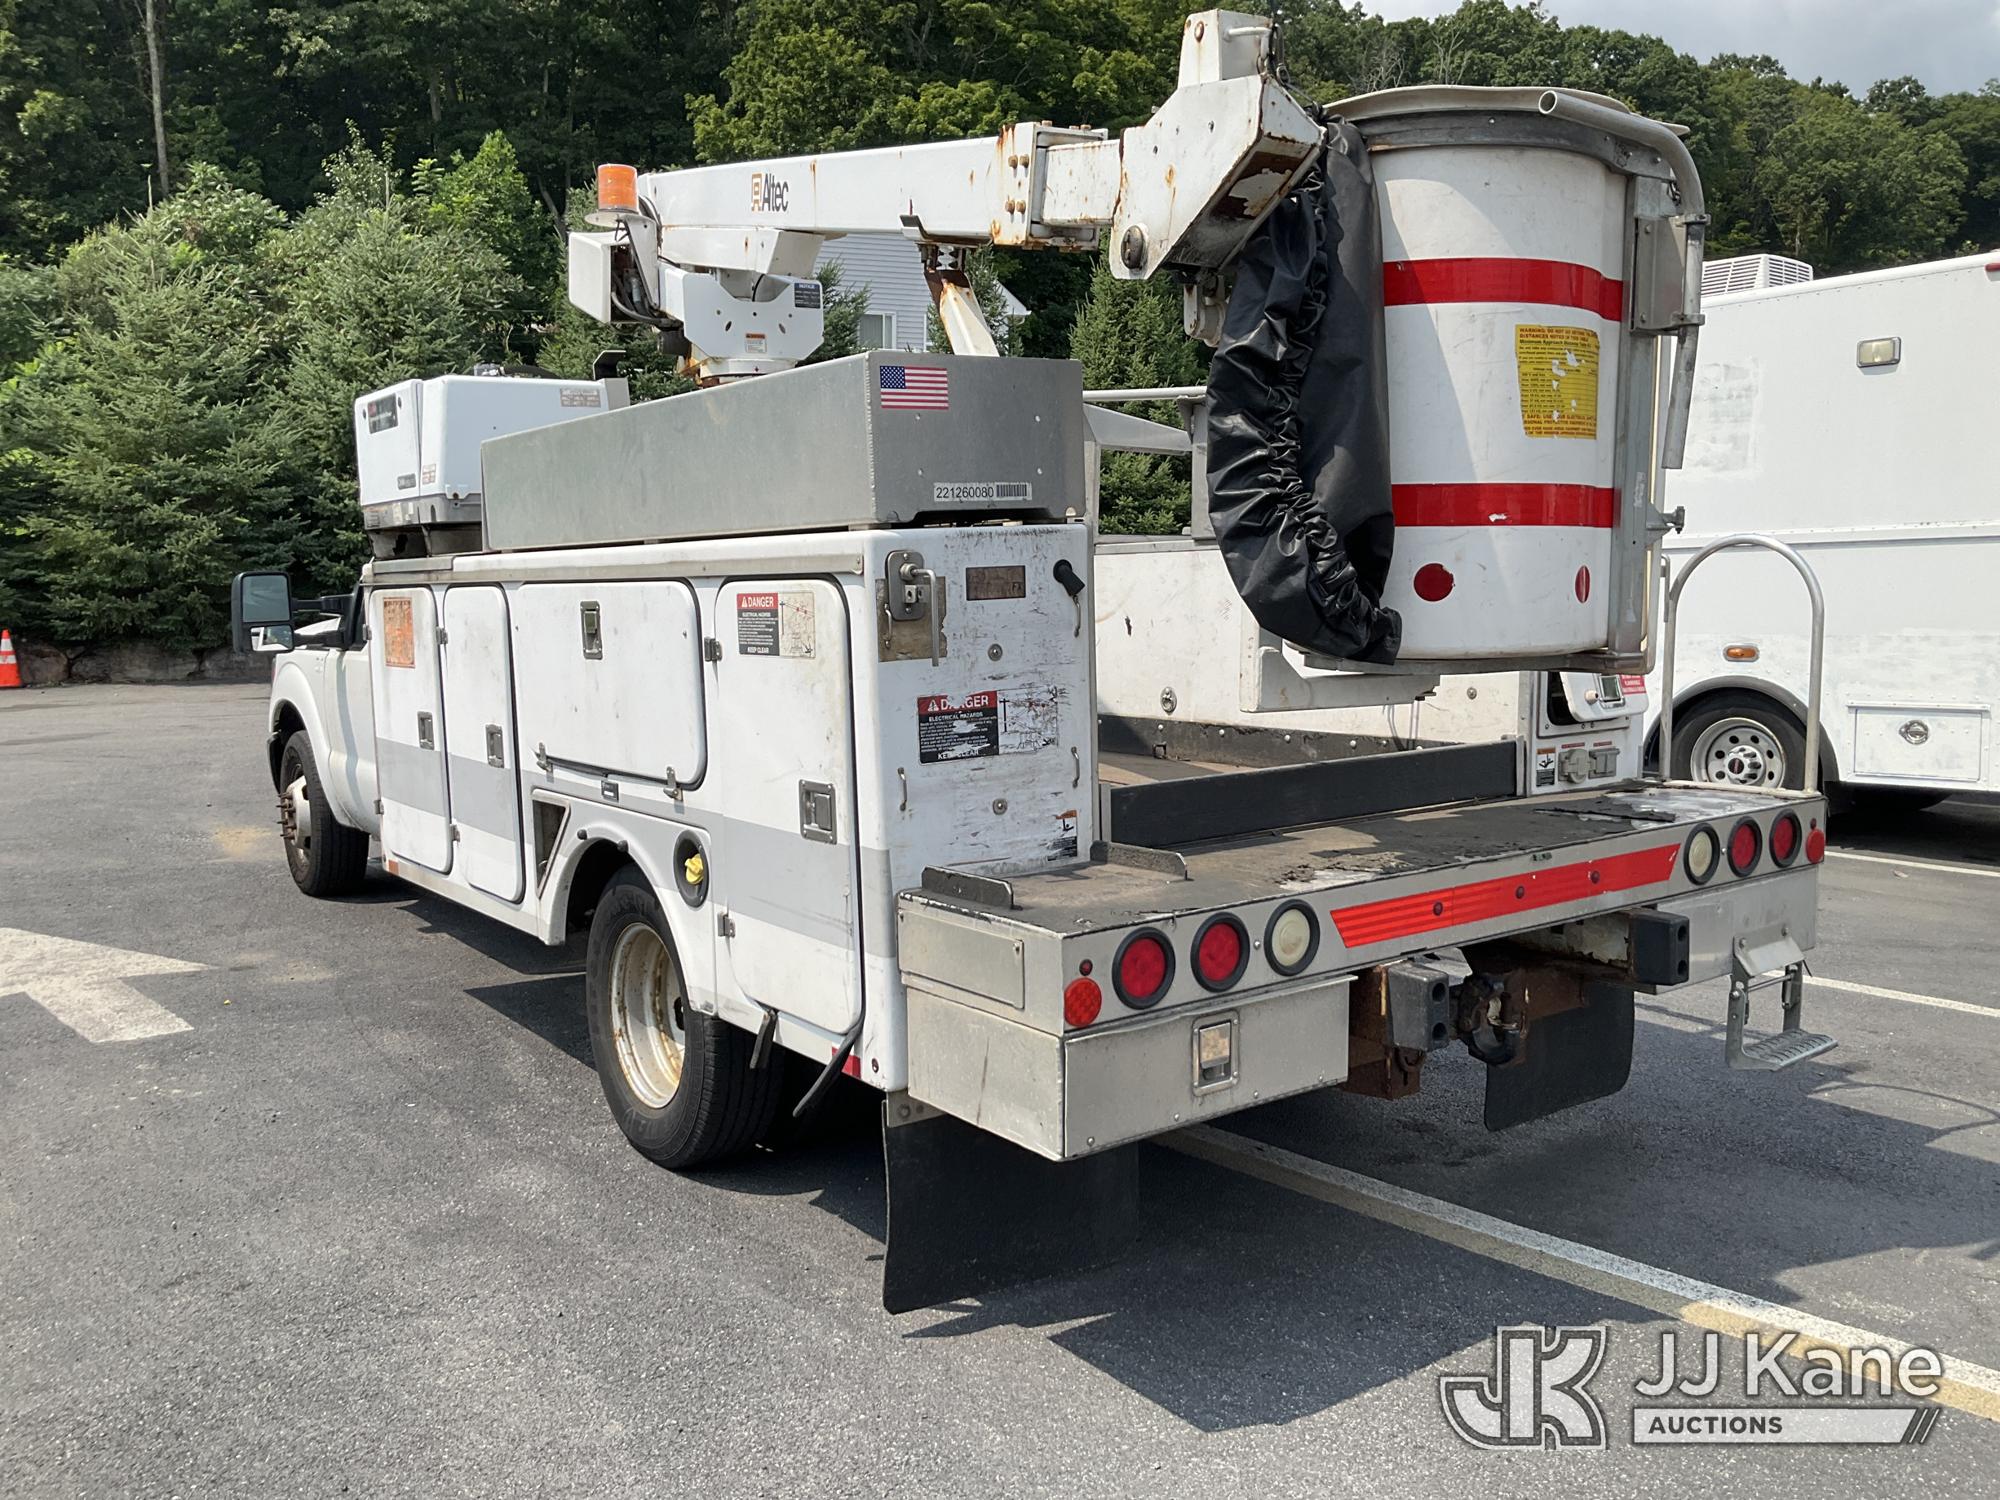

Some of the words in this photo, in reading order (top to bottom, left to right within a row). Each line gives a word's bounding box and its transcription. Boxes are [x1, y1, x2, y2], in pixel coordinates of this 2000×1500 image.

[762, 173, 789, 212] Altec
[936, 486, 994, 498] 221260080
[748, 596, 774, 607] DANGER
[941, 695, 989, 711] DGER
[928, 714, 959, 722] ELECTRICAL
